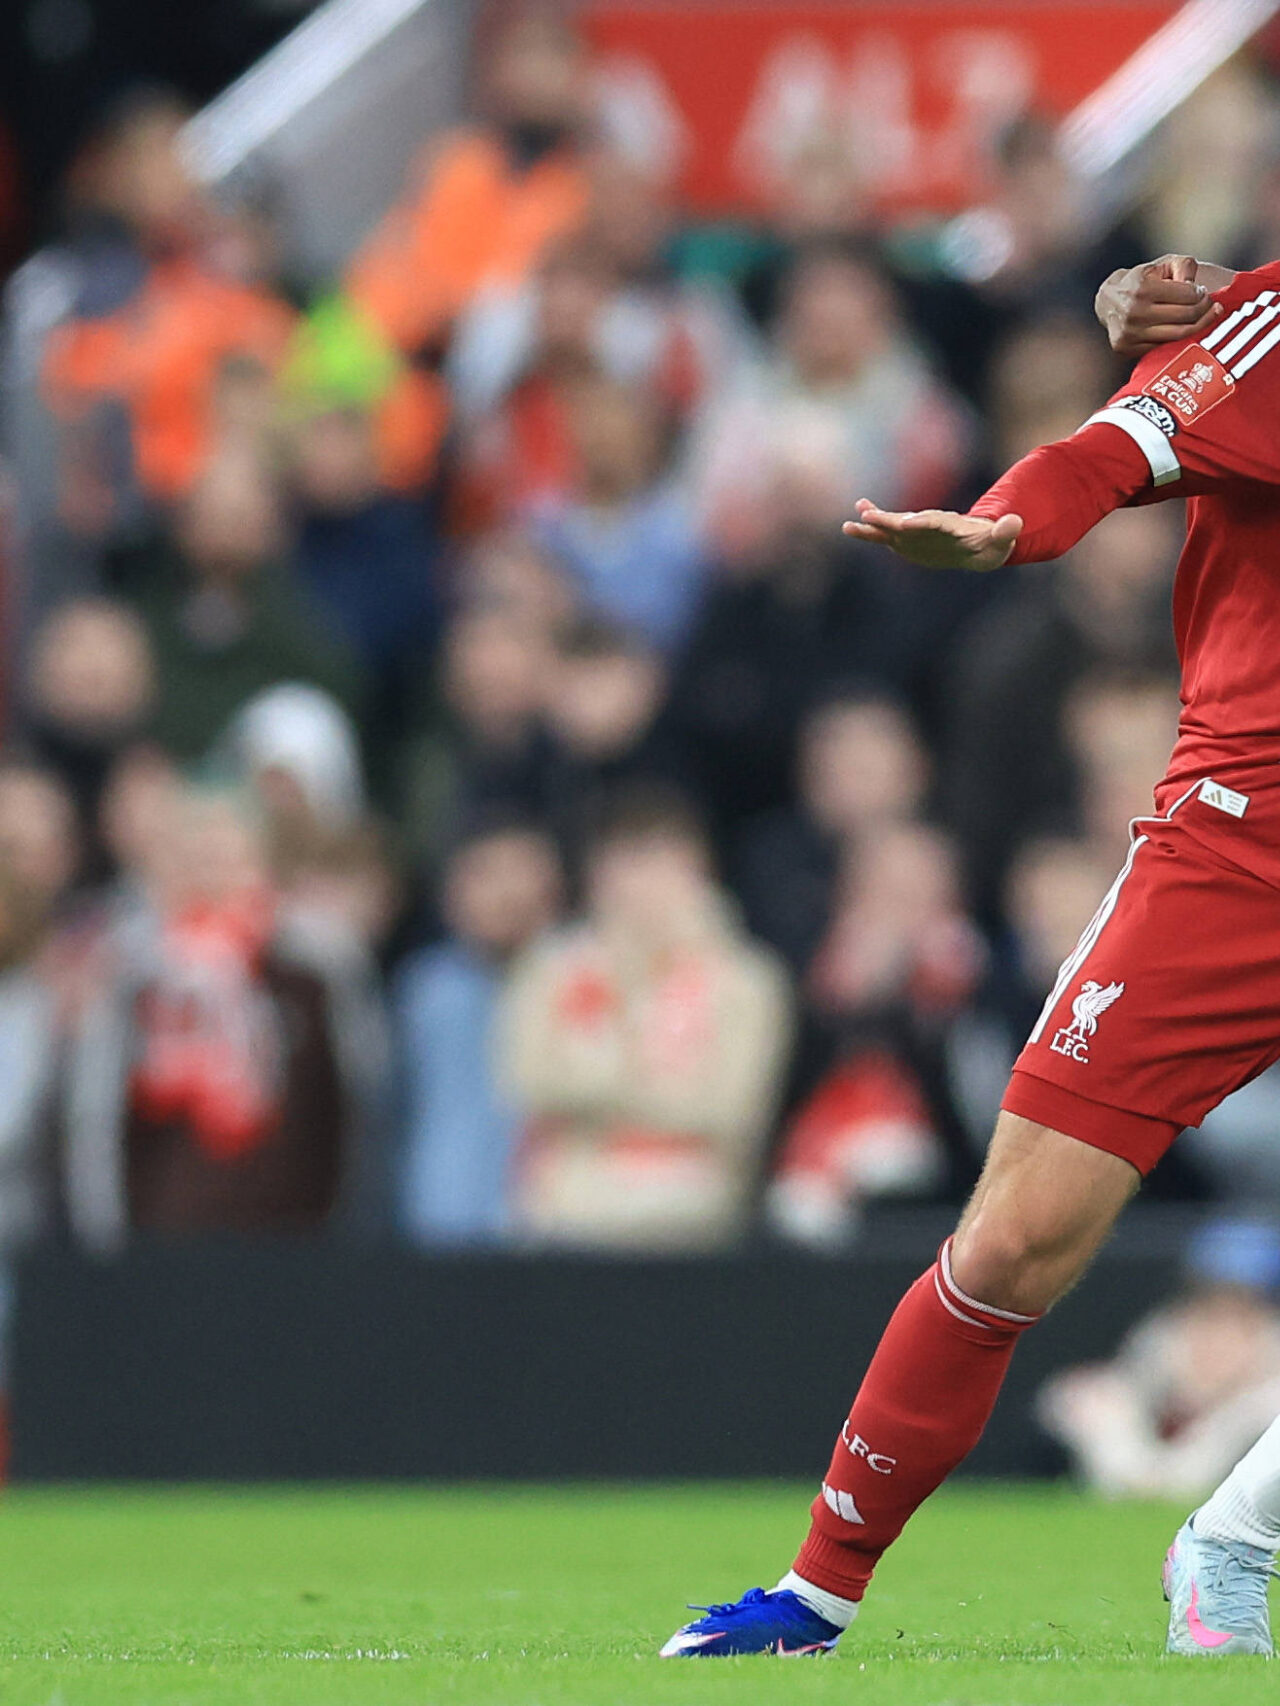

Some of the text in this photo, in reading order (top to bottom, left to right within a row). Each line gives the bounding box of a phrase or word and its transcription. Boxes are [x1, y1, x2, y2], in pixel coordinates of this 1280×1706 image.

[1150, 381, 1169, 397] FA
[1166, 391, 1194, 416] CUP
[842, 1417, 897, 1475] LFC
